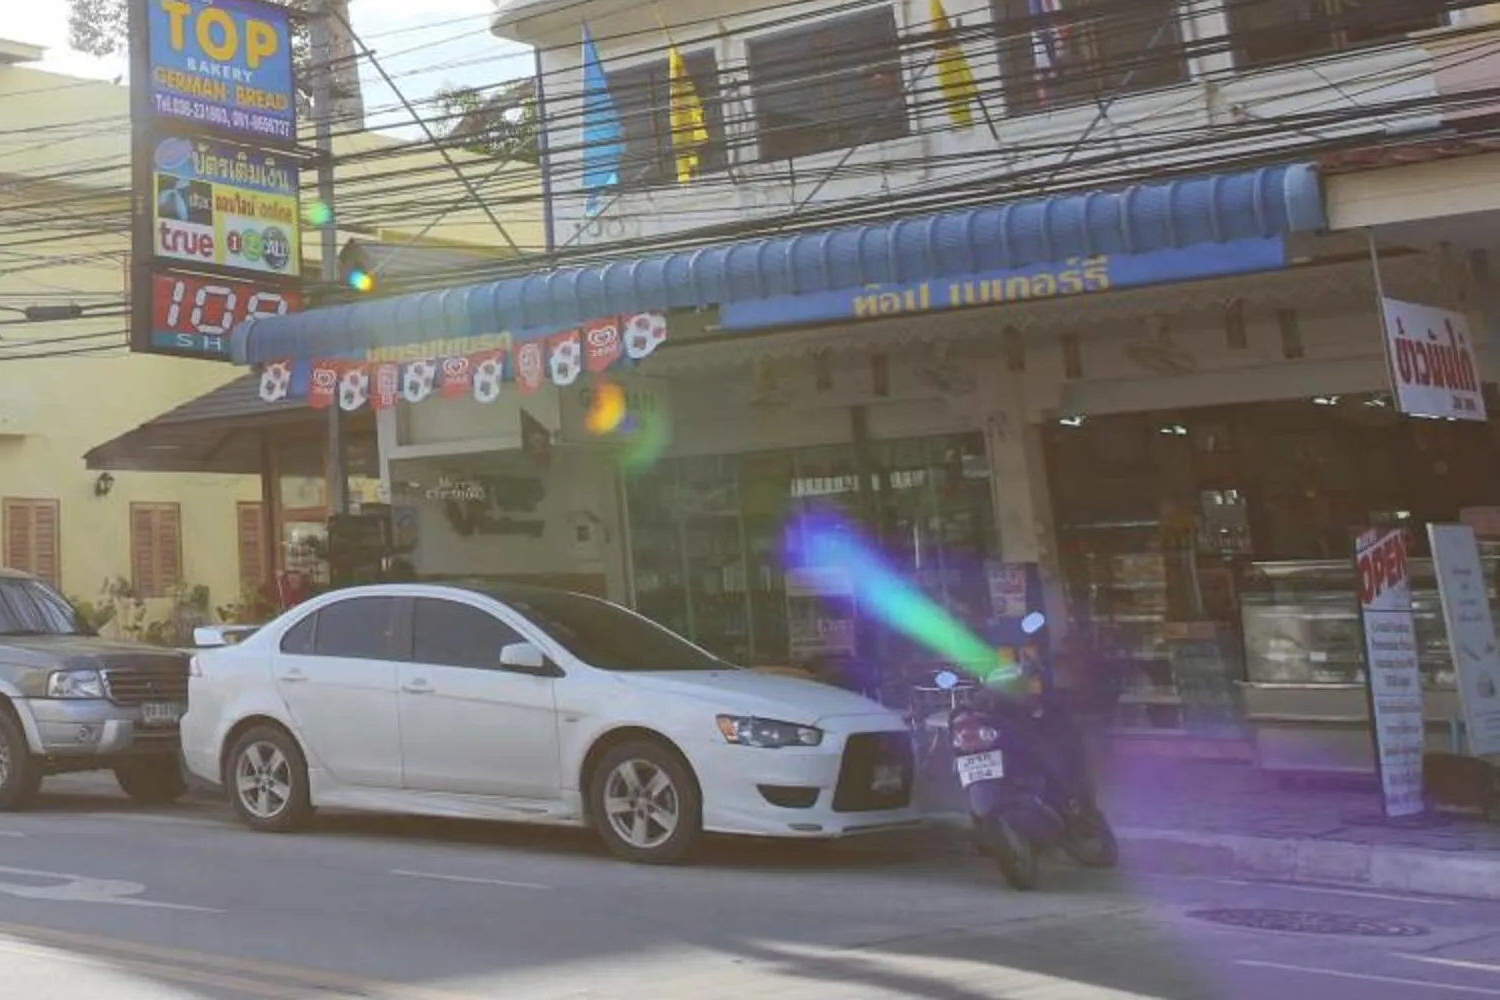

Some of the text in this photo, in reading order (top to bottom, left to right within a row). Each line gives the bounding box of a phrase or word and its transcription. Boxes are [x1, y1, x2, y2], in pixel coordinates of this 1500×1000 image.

[161, 0, 278, 70] TOP
[153, 66, 288, 111] GERMAN BREAD
[187, 57, 253, 83] BAKERY
[160, 221, 214, 258] true
